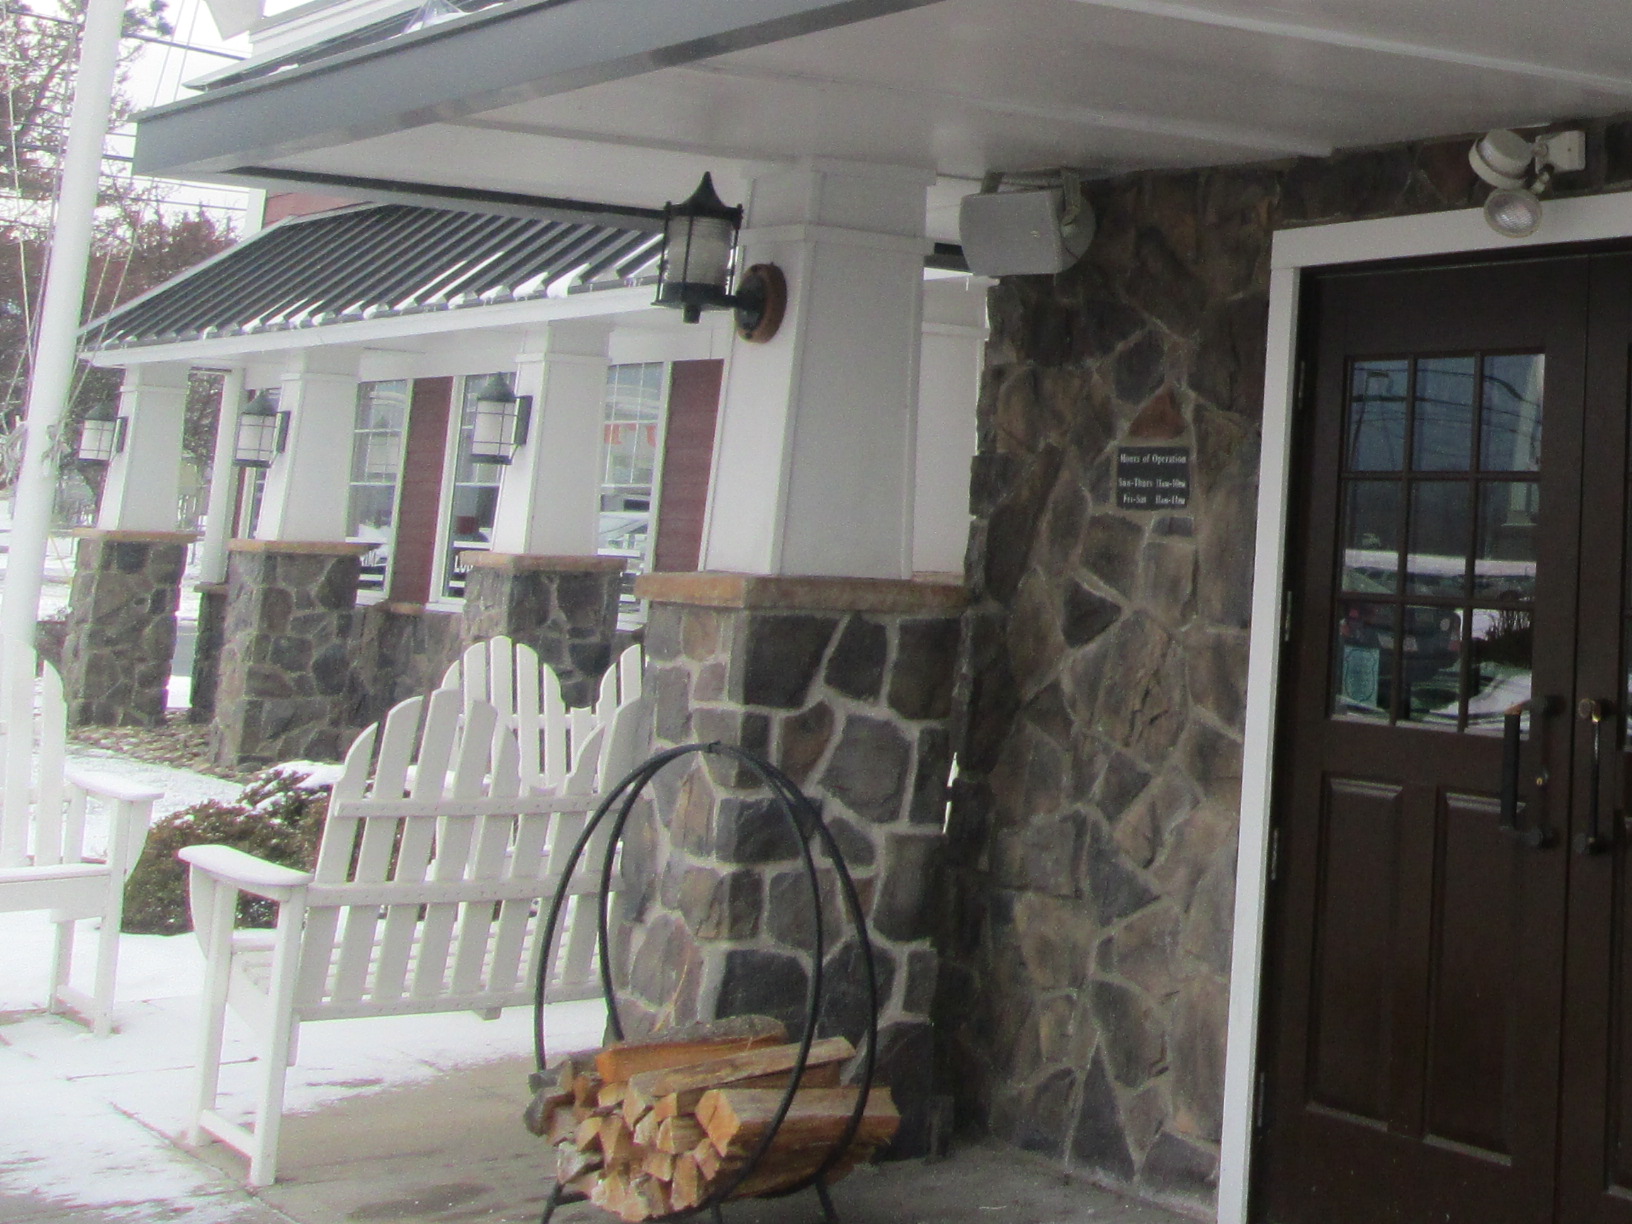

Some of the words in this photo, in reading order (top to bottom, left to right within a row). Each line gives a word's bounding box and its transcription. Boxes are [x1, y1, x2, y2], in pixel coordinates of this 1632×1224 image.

[1120, 453, 1140, 464] Hours
[1142, 453, 1150, 464] of
[1152, 453, 1187, 466] Operation
